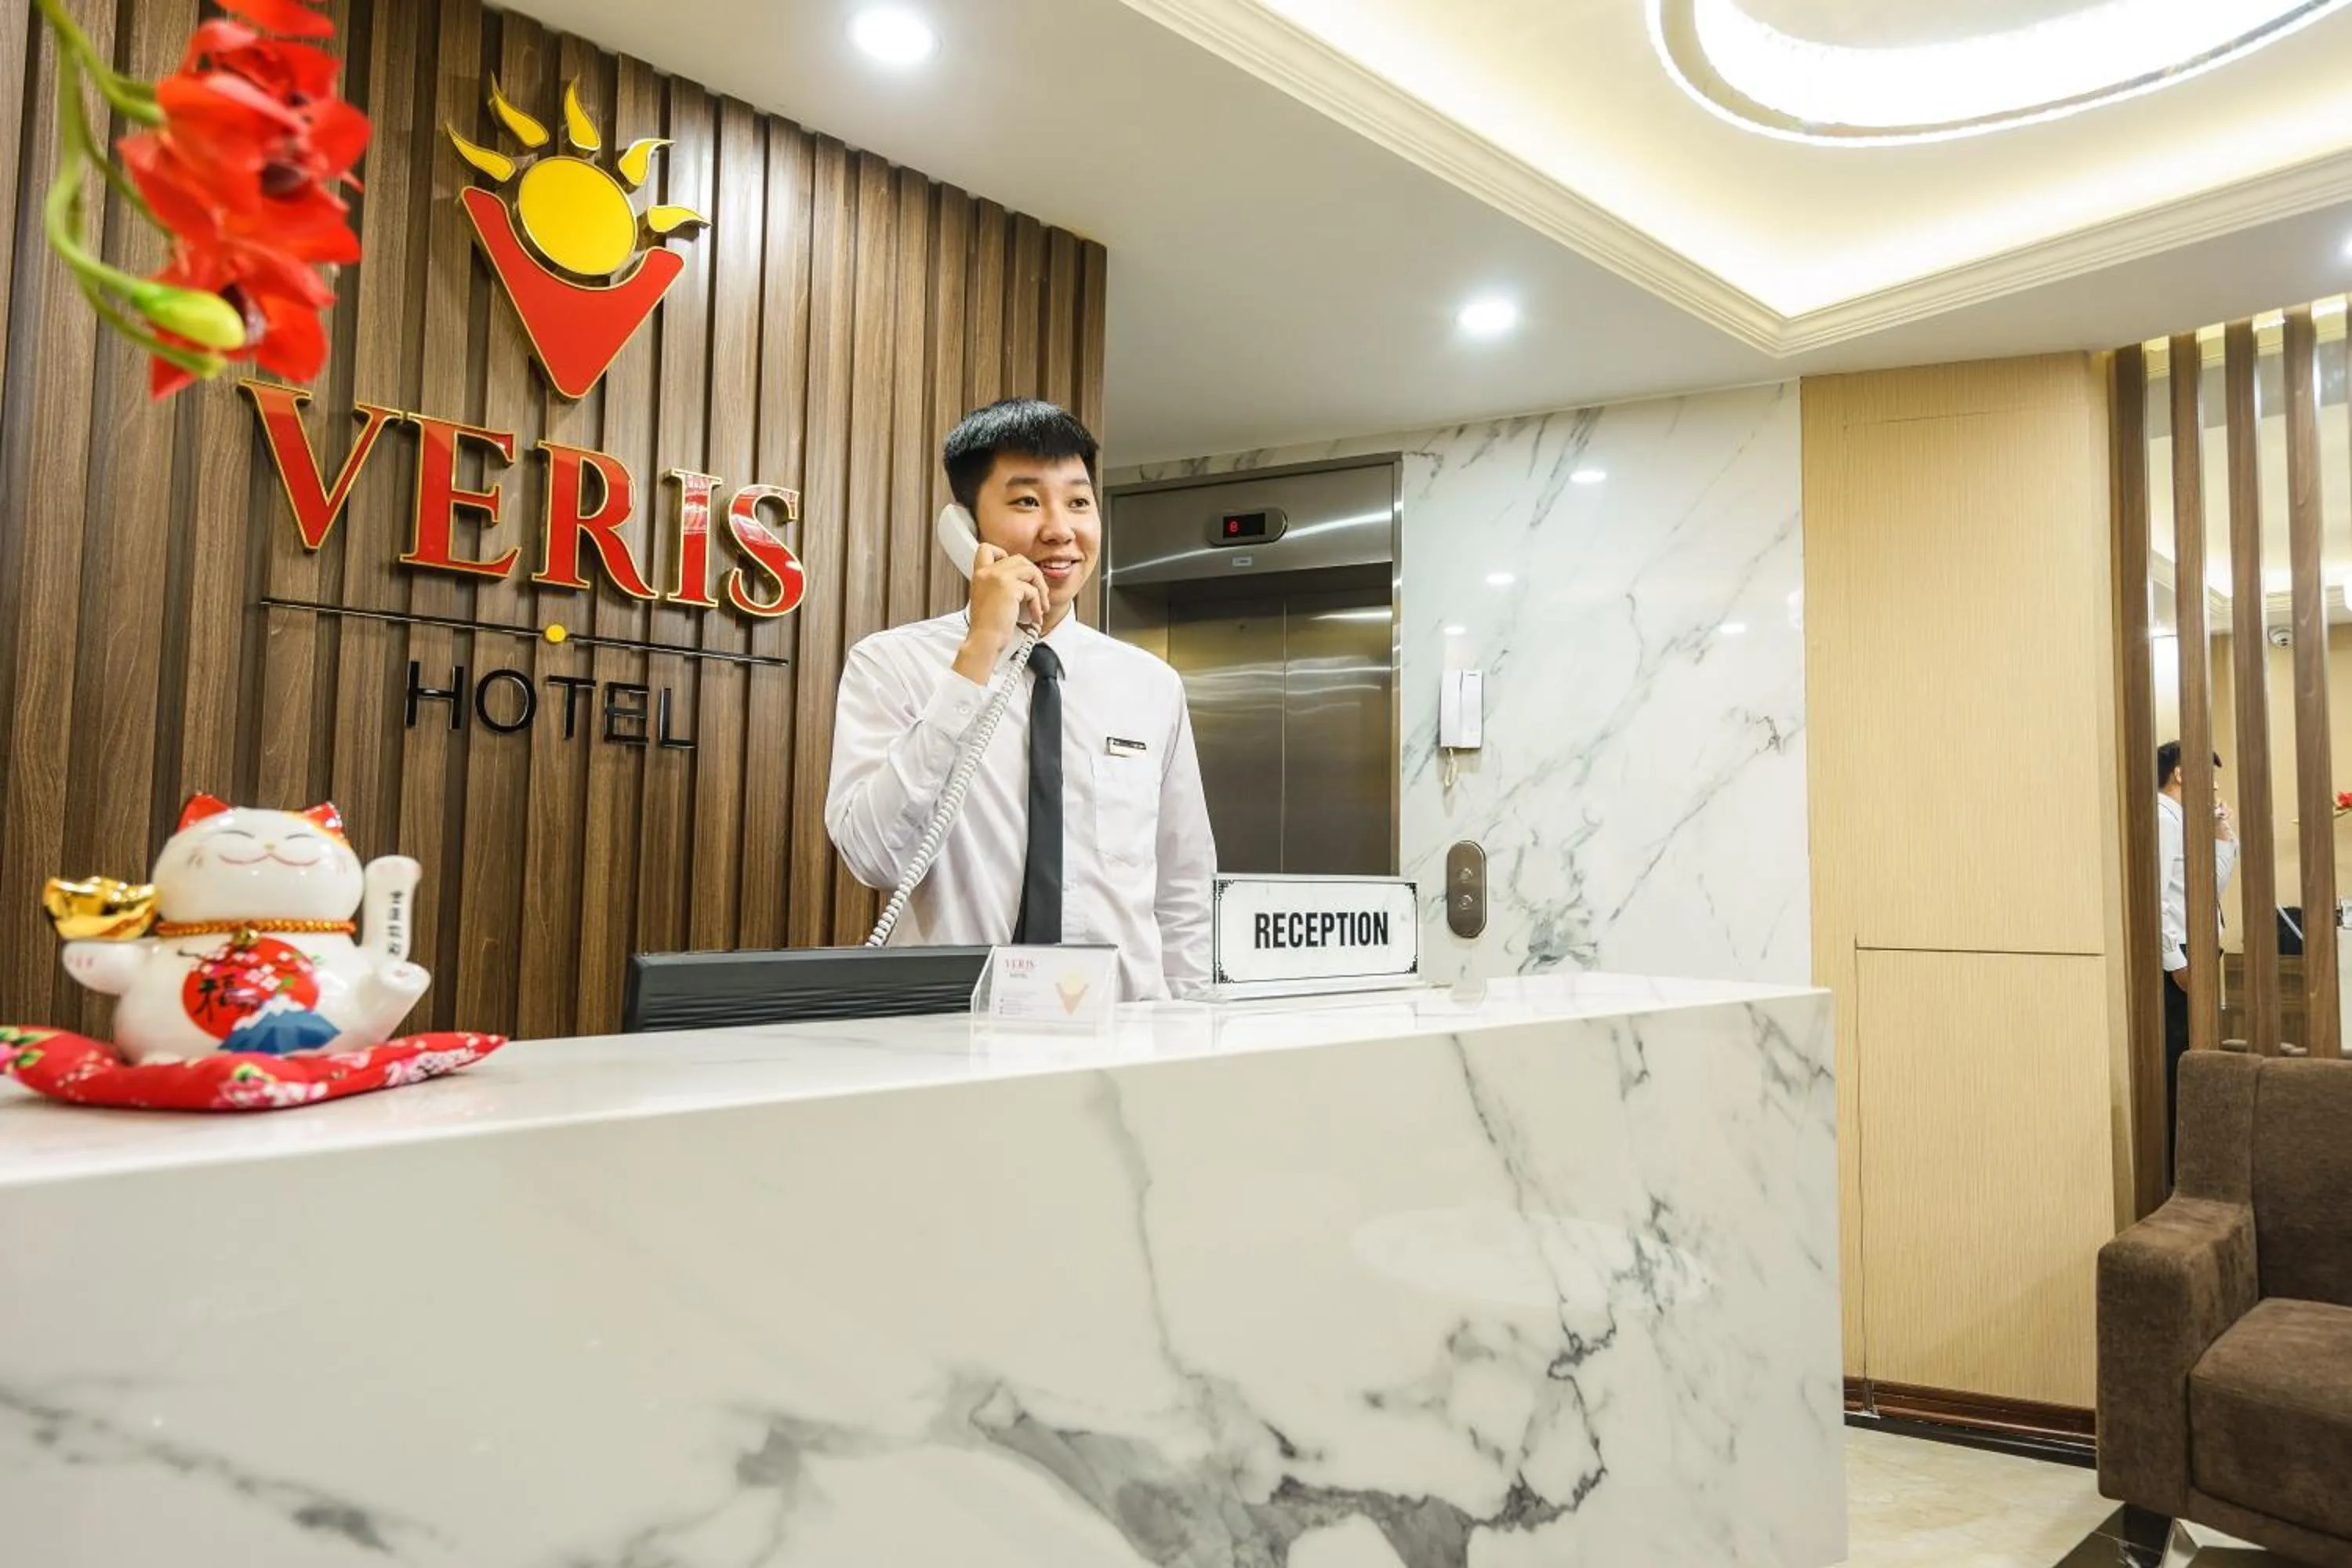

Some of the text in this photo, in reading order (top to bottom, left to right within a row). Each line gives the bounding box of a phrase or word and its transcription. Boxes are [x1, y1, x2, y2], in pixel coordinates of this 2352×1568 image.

[238, 377, 807, 618] VERIS
[405, 660, 697, 750] HOTEL
[1254, 911, 1388, 949] RECEPTION
